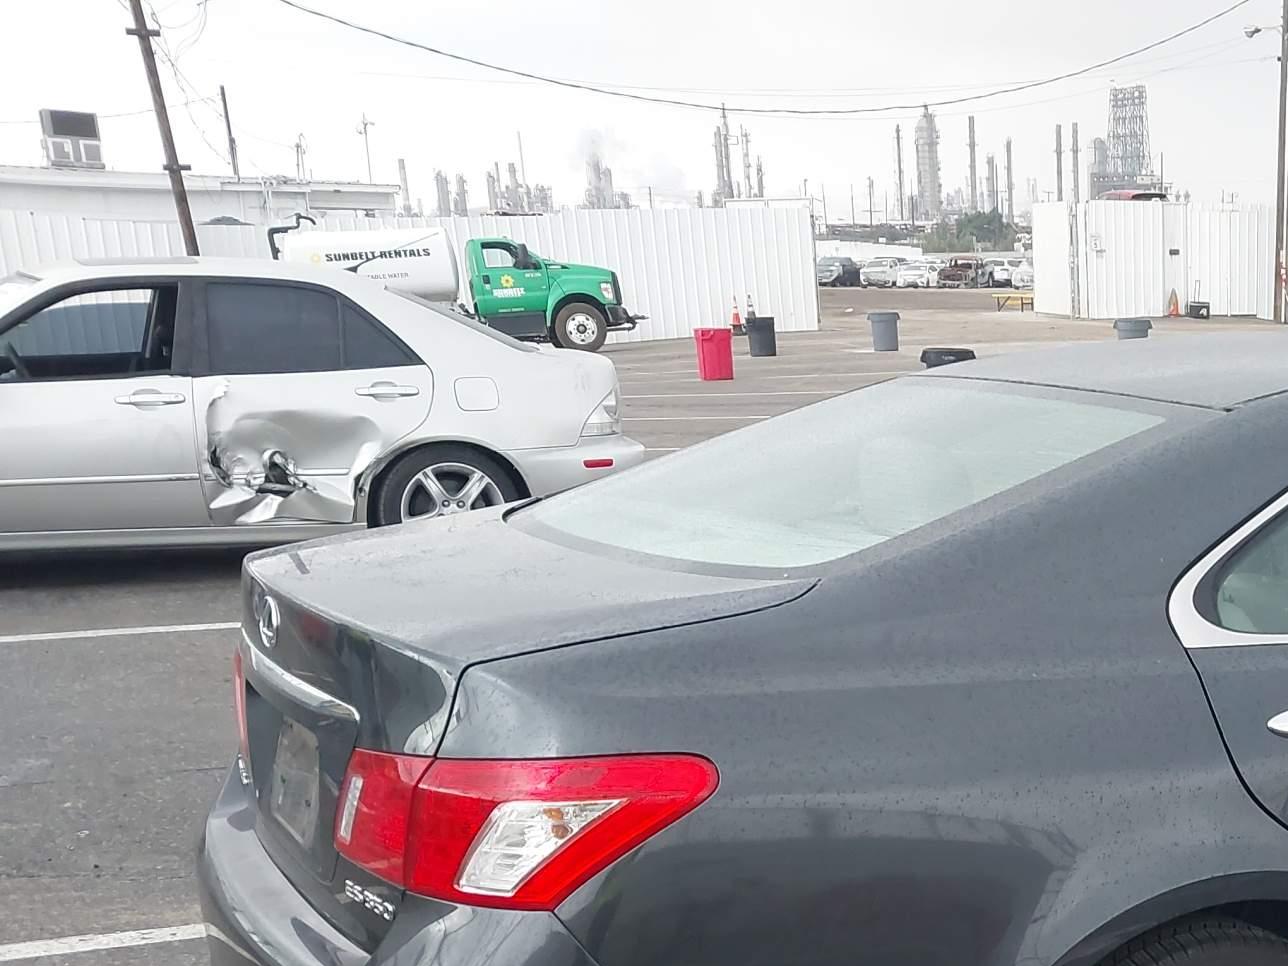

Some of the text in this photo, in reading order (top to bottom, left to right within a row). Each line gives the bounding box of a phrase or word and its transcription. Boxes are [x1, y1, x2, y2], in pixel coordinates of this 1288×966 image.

[325, 248, 431, 262] SUNBELT RENTALS
[345, 880, 395, 921] ES 350
